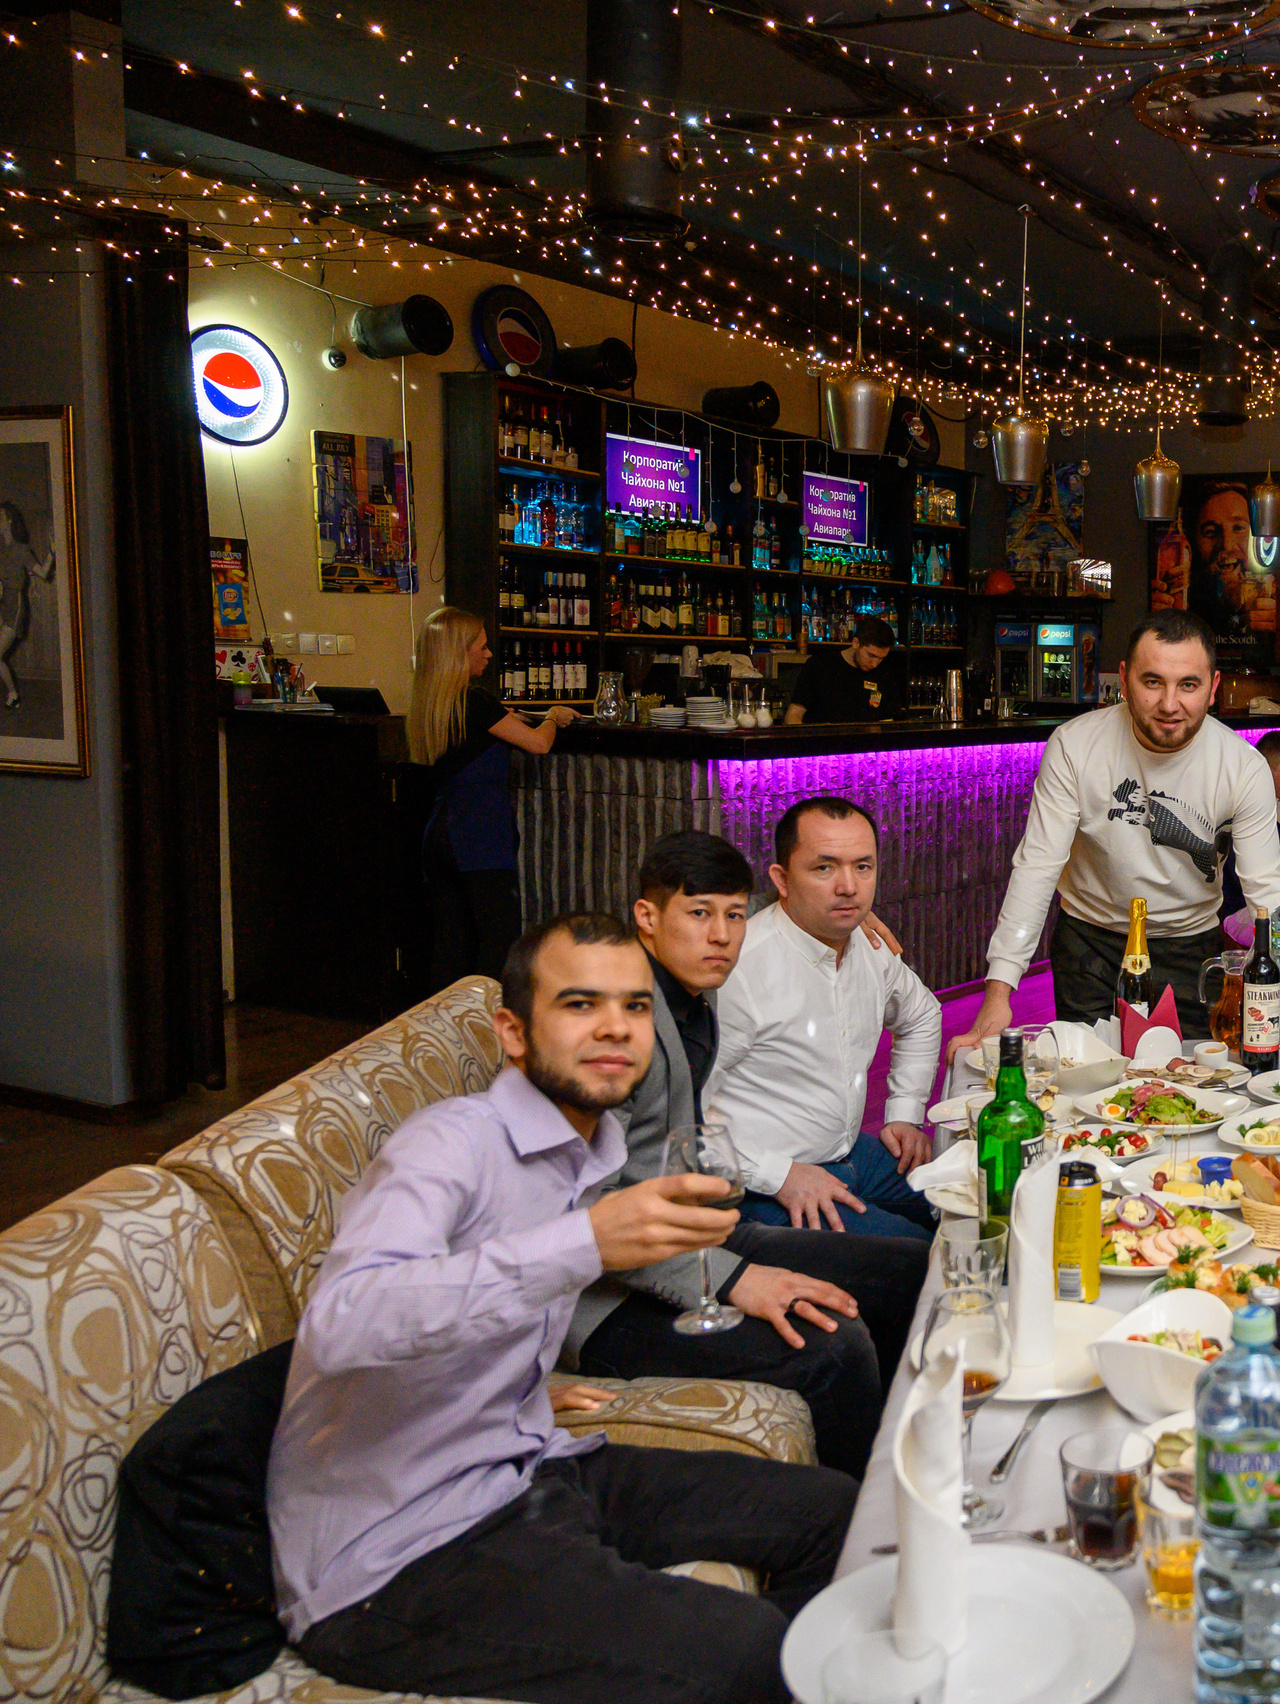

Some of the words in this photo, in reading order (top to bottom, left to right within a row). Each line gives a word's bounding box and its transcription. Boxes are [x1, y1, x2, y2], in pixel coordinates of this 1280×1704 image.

[621, 471, 665, 490] Чайхона
[667, 478, 686, 494] №1
[809, 485, 856, 503] Короратив
[807, 503, 841, 518] Чайхона
[842, 508, 857, 521] №1
[1008, 629, 1029, 637] pepsi
[1050, 629, 1071, 639] pepsi
[1215, 634, 1228, 644] the
[1228, 634, 1258, 645] Scotch.
